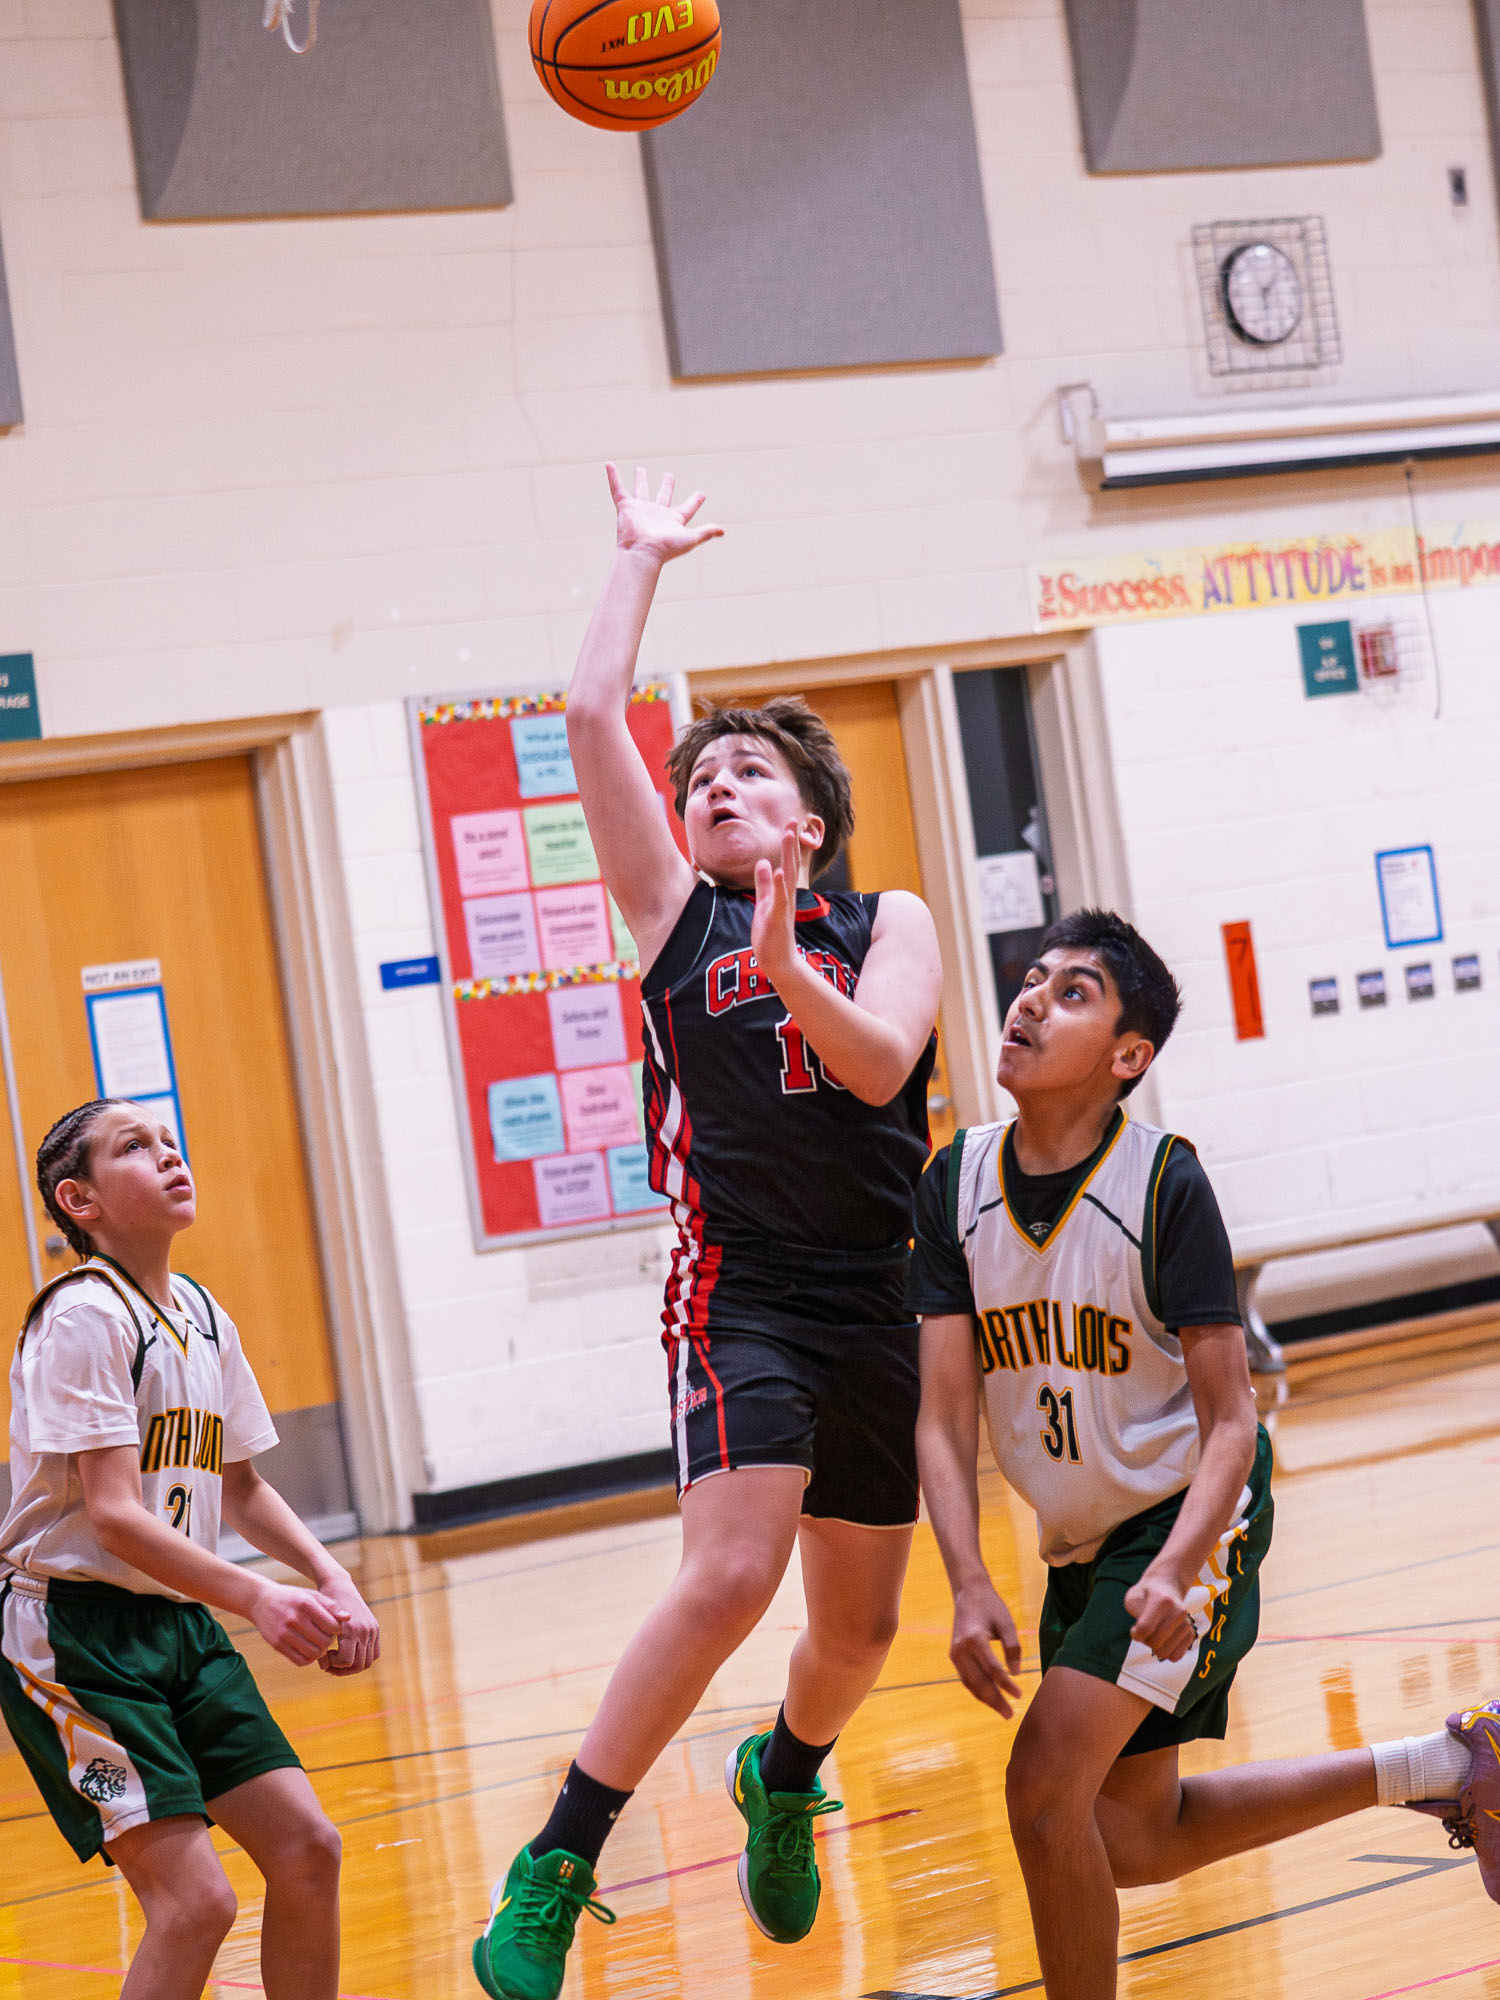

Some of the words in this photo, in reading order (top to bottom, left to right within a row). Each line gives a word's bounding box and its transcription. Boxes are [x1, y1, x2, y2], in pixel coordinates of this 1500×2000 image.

[600, 36, 626, 53] NXT
[604, 49, 717, 104] Wilson
[1056, 571, 1194, 620] Success
[1202, 543, 1366, 610] ATTITUDE
[85, 972, 110, 984] NOT
[113, 970, 130, 984] AN
[132, 967, 156, 981] EXIT
[1036, 1382, 1083, 1465] 31
